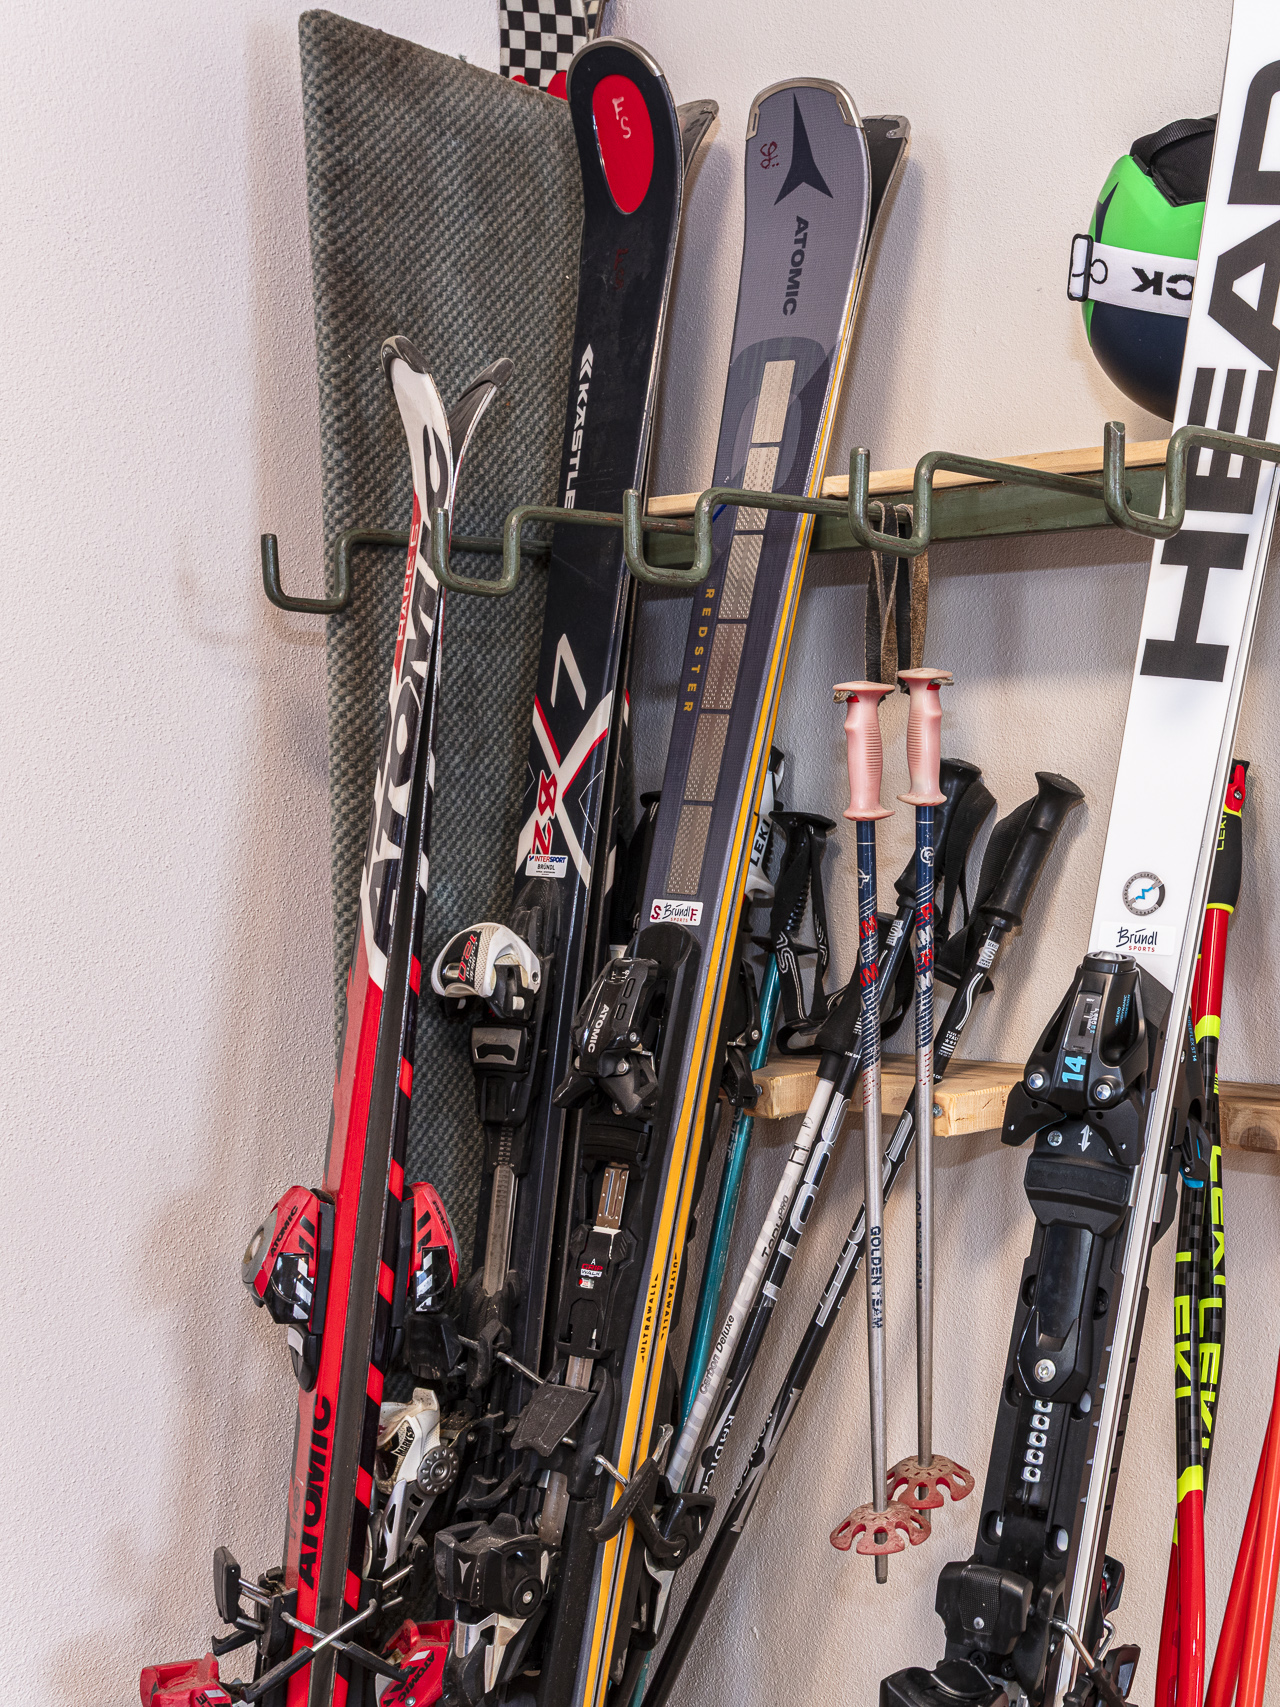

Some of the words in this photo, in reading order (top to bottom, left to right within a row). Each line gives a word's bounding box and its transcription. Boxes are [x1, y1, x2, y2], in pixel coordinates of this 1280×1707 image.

[782, 215, 809, 316] ATOMIC
[397, 557, 415, 640] RACE
[683, 588, 715, 712] REDSTER
[534, 855, 566, 863] INTERSPORT
[750, 818, 770, 867] LEKI
[1128, 945, 1155, 953] SPORTS
[587, 1004, 610, 1053] ATOMIC
[1061, 1055, 1087, 1083] 14
[271, 1205, 298, 1258] ATOMIC
[870, 1225, 883, 1286] GOLDEN
[641, 1284, 657, 1353] ULTRAWALL
[662, 1262, 678, 1330] ULTRAWALL
[871, 1289, 883, 1329] TEAM
[700, 1354, 721, 1395] Carbon
[715, 1313, 735, 1354] Deluxe
[299, 1394, 331, 1590] ATOMIC
[398, 1651, 435, 1703] ATOMIC
